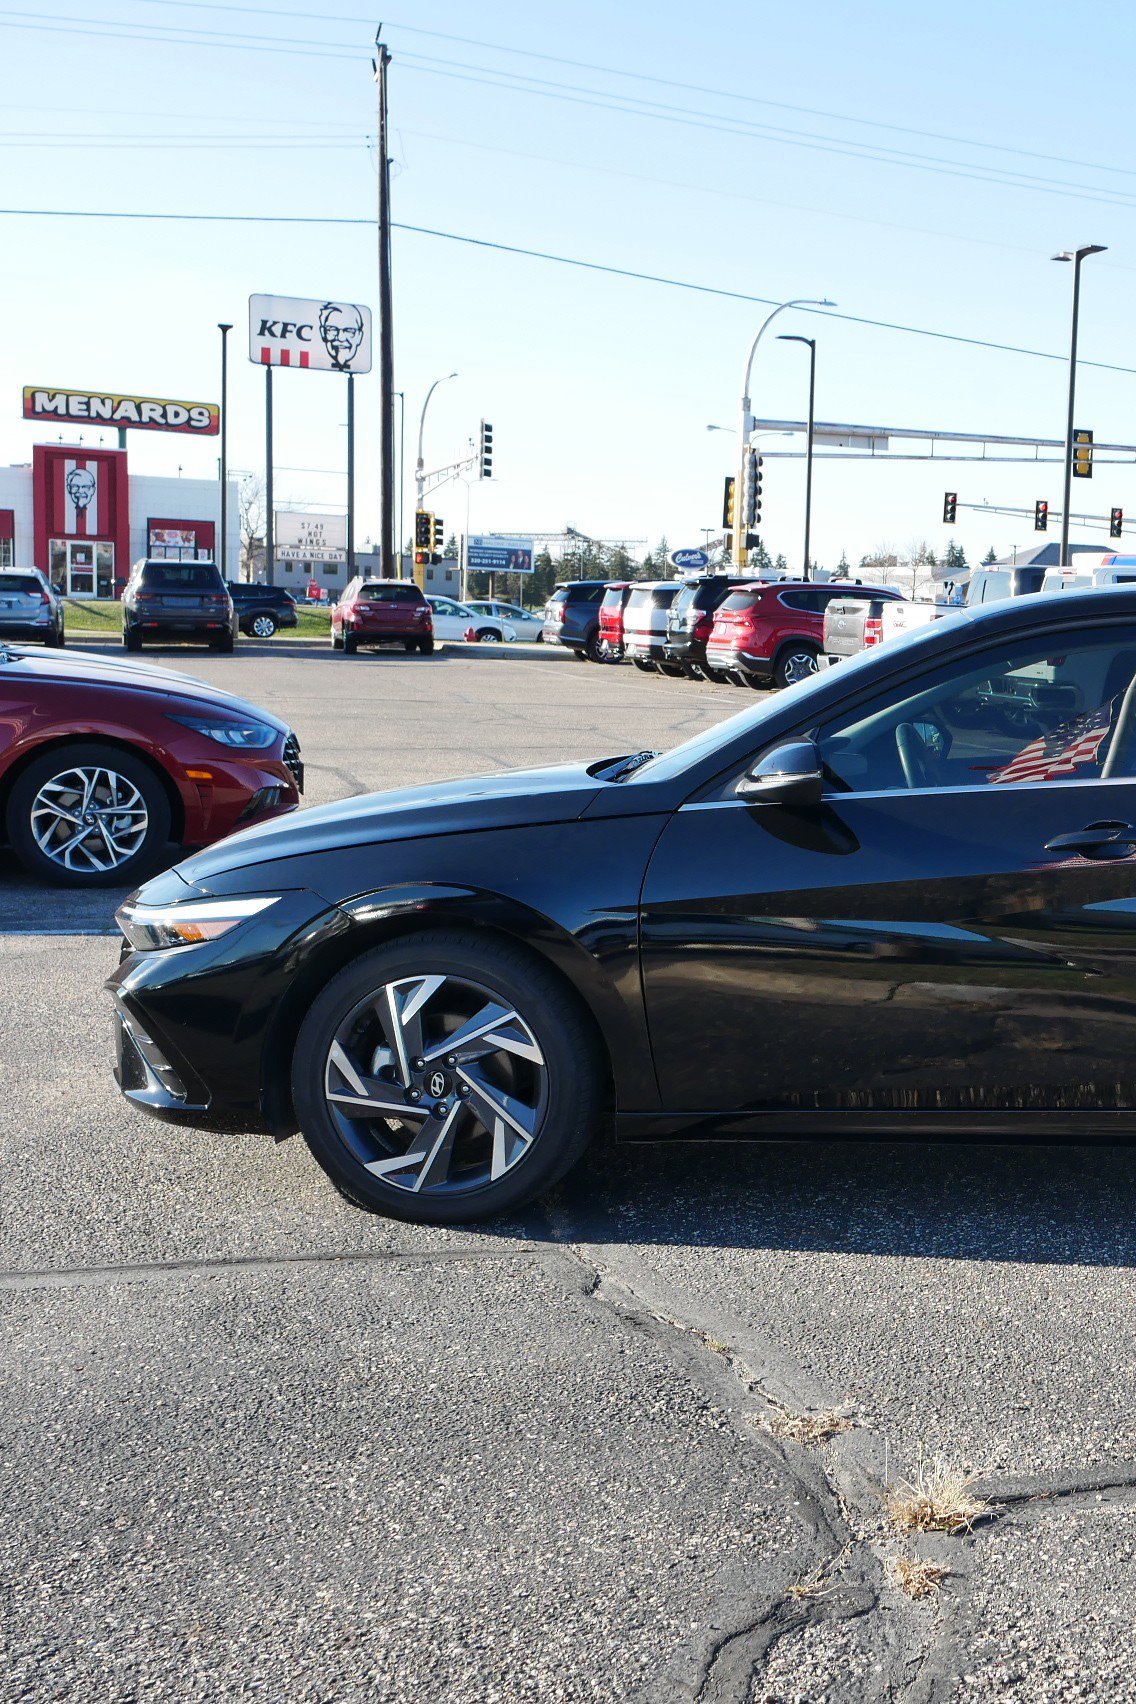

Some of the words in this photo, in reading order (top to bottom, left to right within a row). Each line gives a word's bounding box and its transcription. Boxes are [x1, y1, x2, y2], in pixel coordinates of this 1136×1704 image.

[257, 318, 314, 342] KFC
[32, 390, 212, 428] MENARDS
[297, 537, 327, 546] WINGS
[281, 550, 299, 558] HAVE
